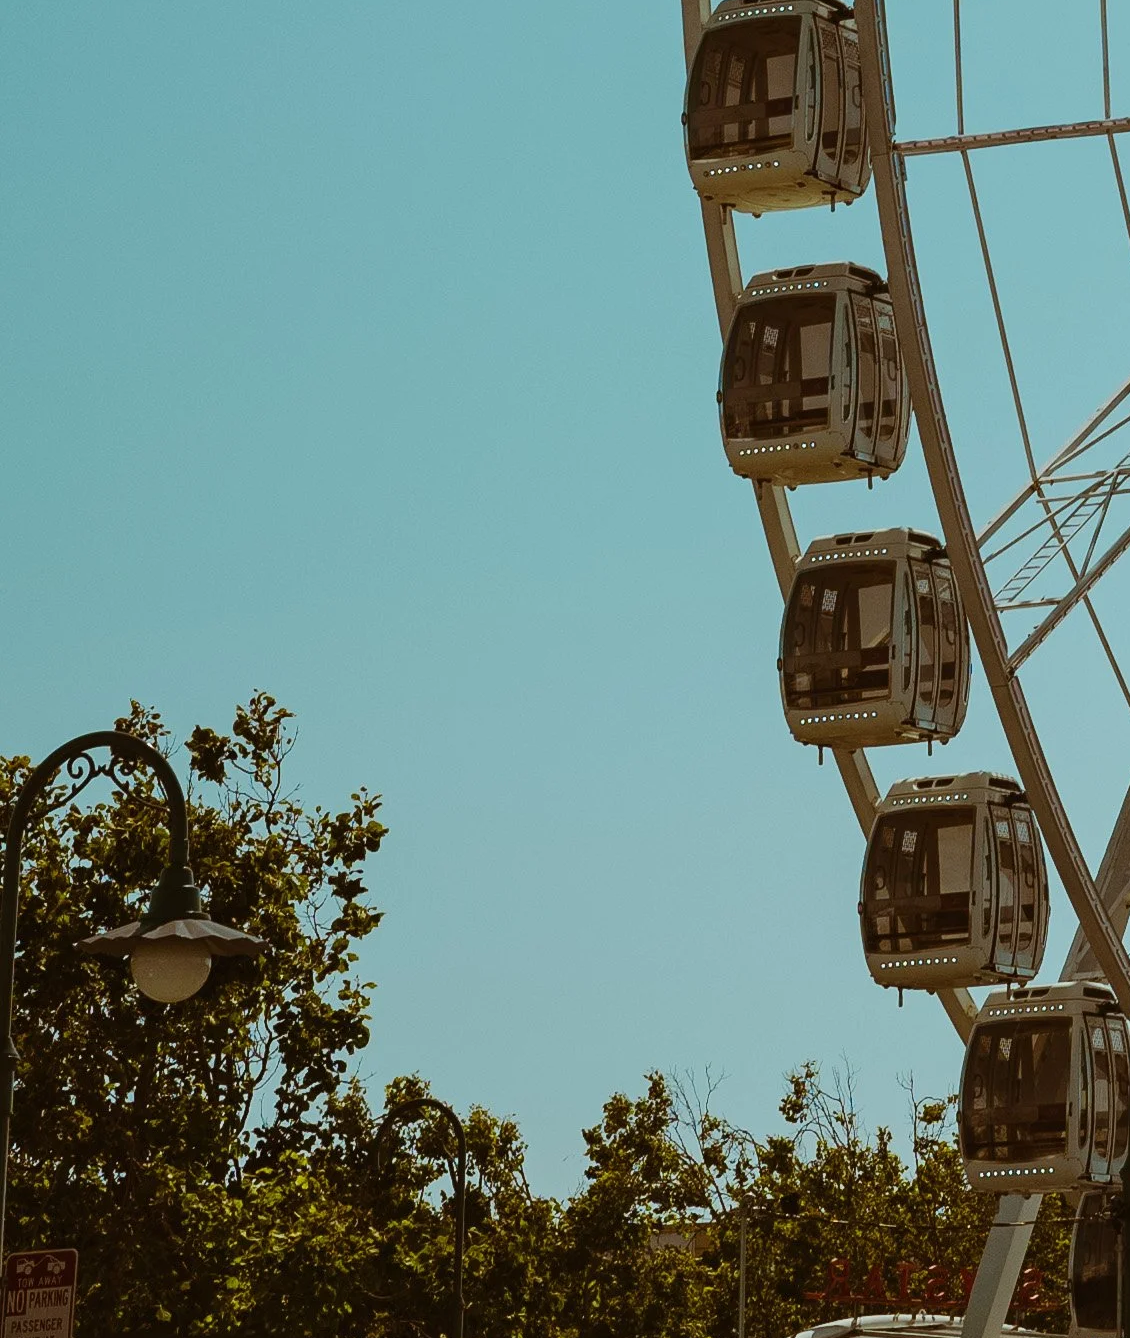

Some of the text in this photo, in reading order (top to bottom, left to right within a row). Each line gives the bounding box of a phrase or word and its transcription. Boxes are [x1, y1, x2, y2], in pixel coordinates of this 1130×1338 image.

[17, 1275, 64, 1288] TOW AWAY
[6, 1289, 69, 1314] NO PARKING
[11, 1317, 63, 1334] PASSENGER
